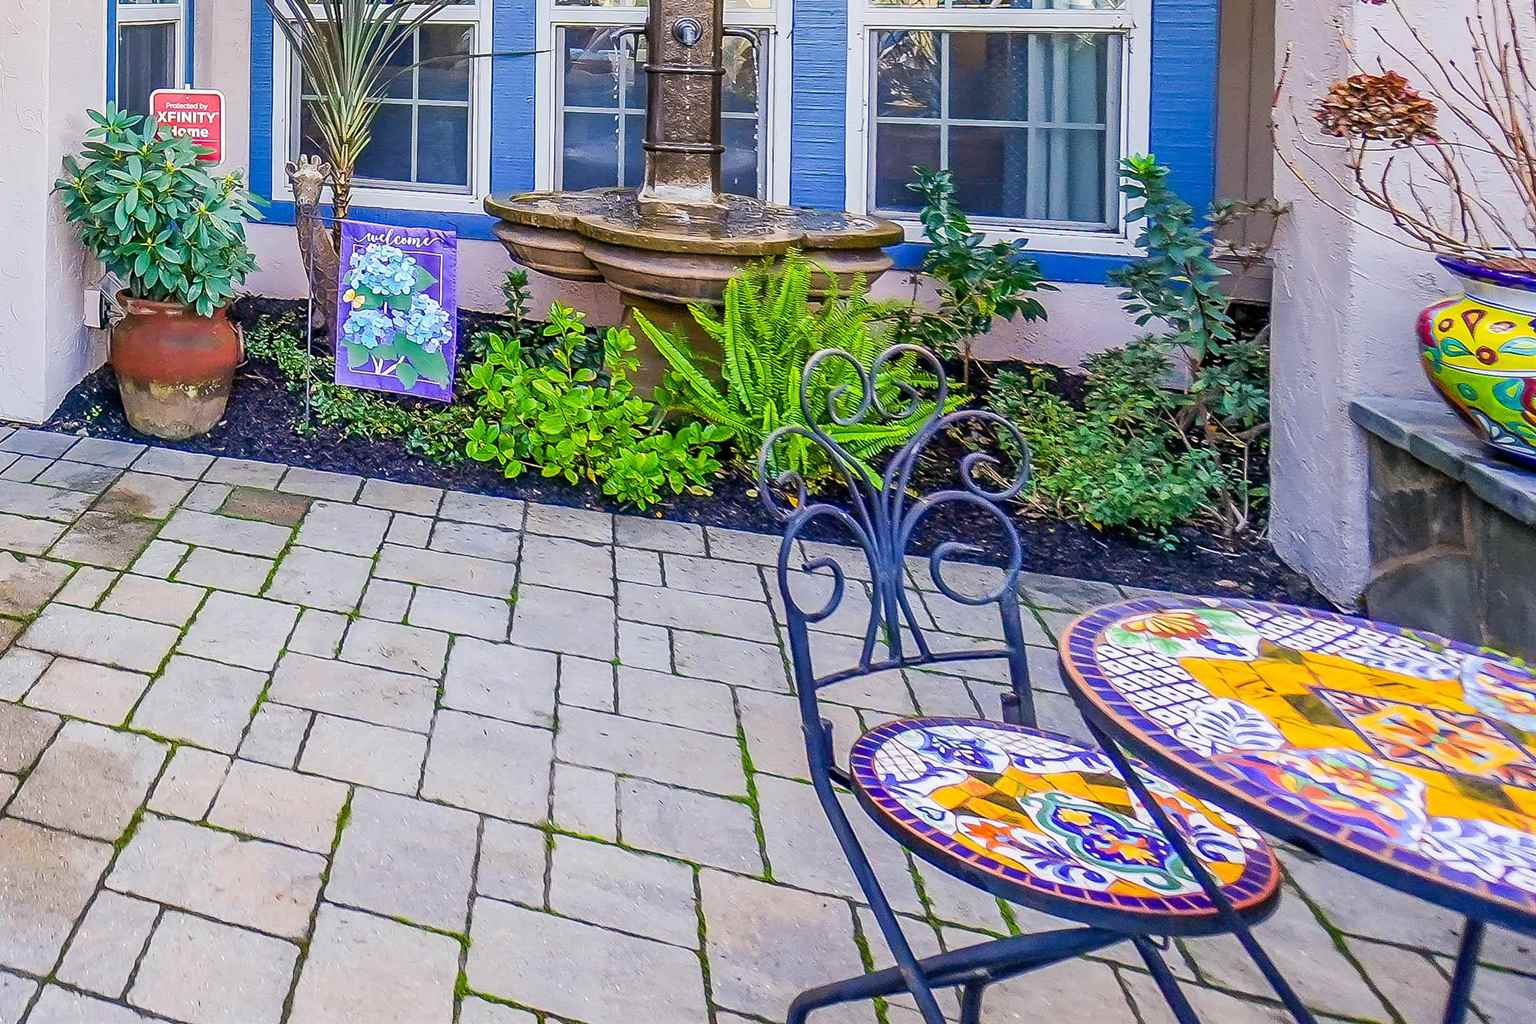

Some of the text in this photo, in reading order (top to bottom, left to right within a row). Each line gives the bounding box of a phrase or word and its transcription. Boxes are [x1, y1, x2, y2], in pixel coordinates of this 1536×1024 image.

[166, 102, 209, 111] Protected by
[157, 111, 216, 124] XFINITY
[354, 229, 444, 248] welcome
